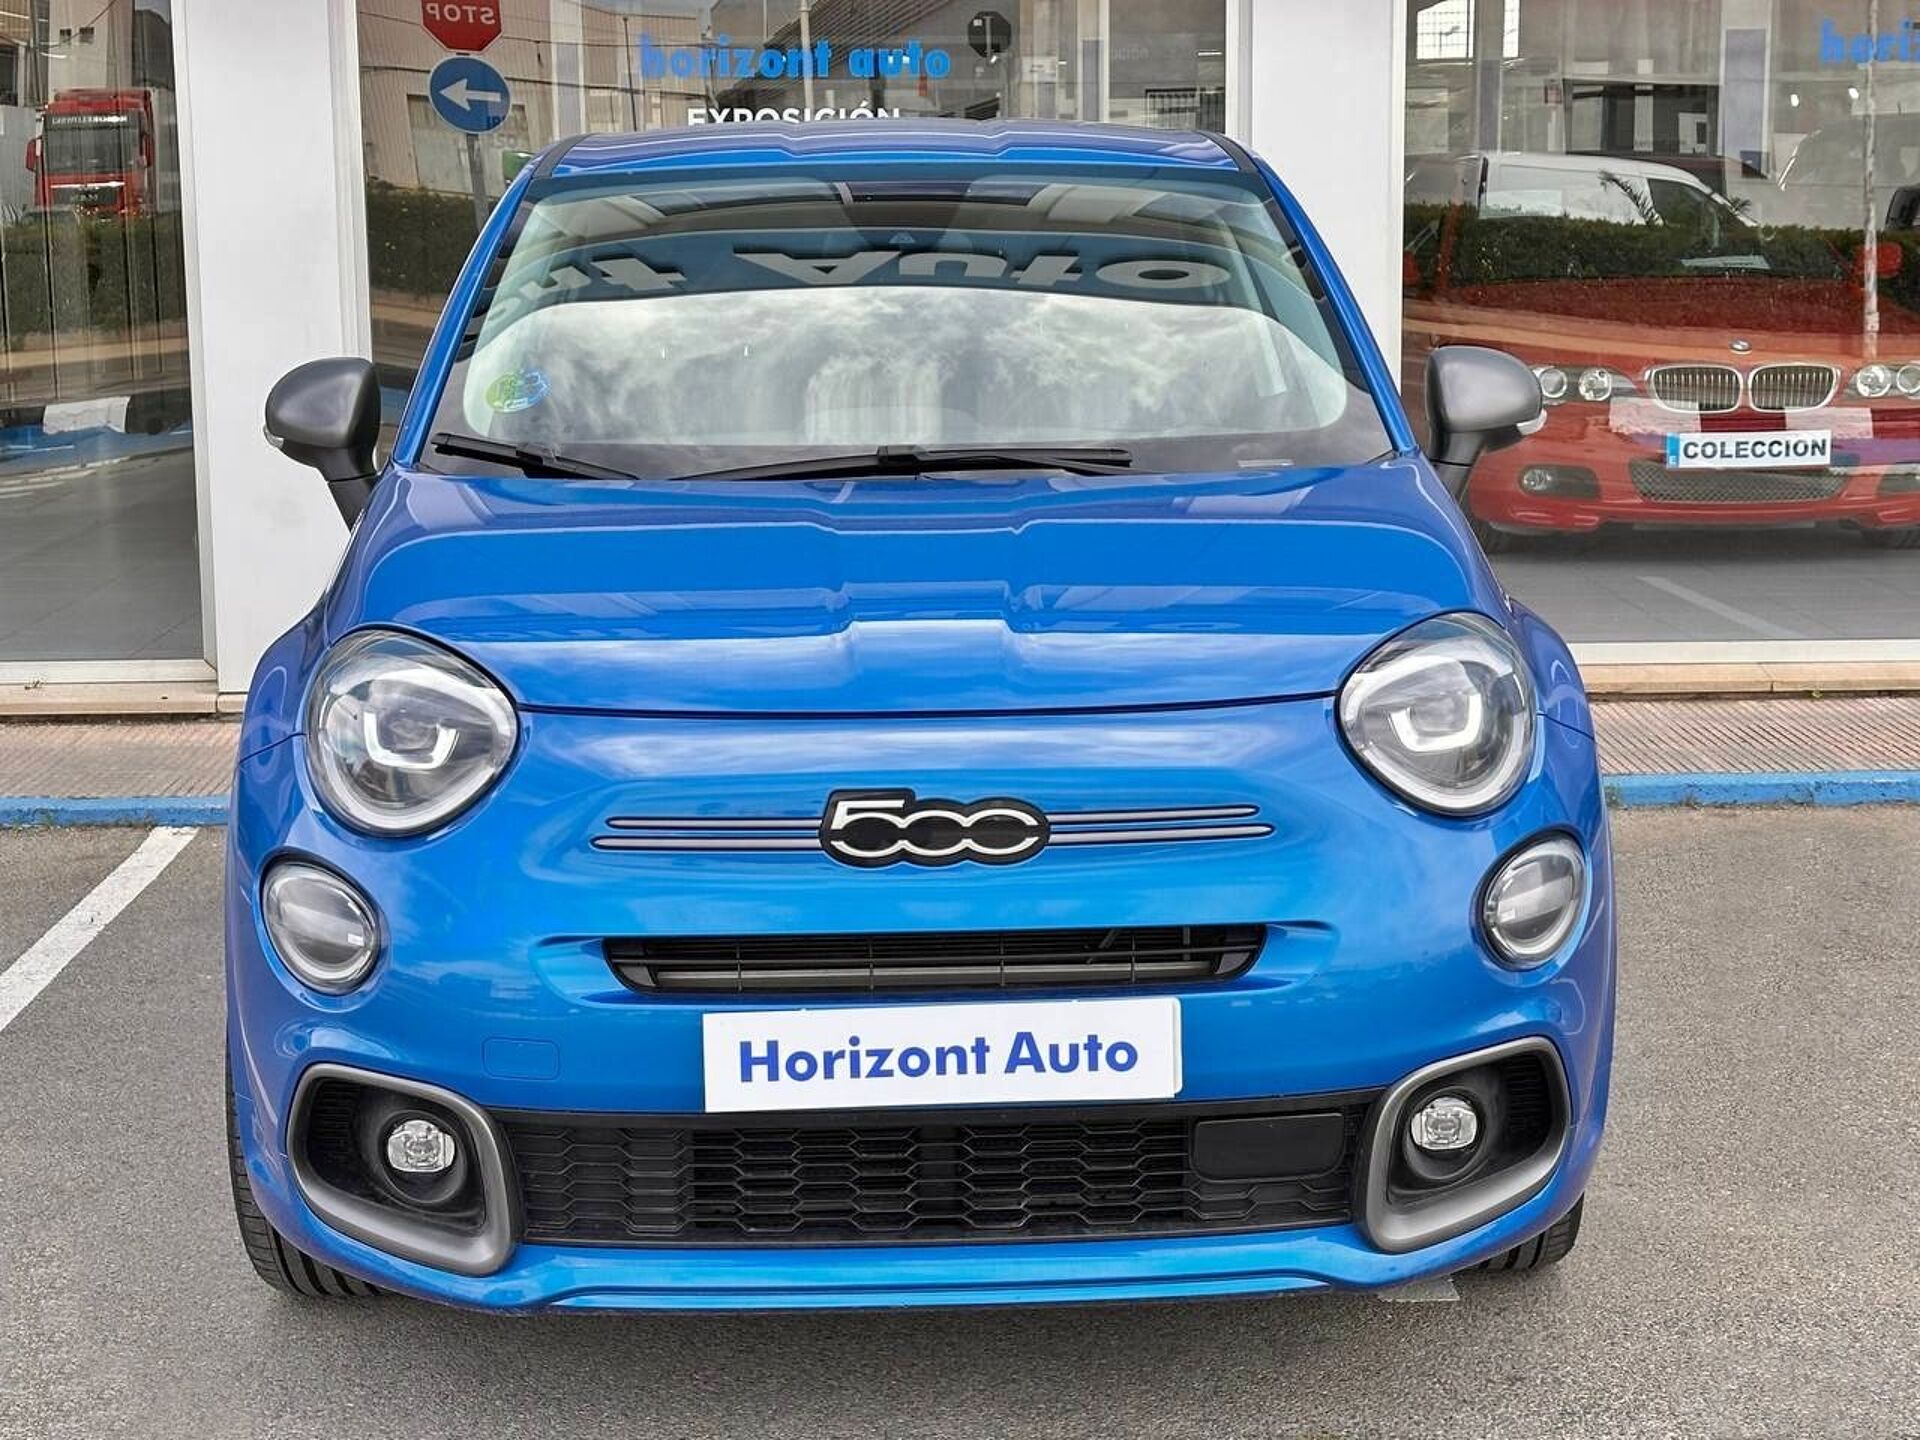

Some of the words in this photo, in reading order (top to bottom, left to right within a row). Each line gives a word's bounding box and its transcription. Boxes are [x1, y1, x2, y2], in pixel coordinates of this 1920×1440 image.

[640, 34, 831, 79] horizont
[849, 39, 950, 79] auto
[1820, 18, 1920, 63] hori
[1683, 439, 1826, 459] COLECCION
[830, 799, 1039, 858] 500
[739, 1035, 990, 1083] Horizont
[1004, 1031, 1138, 1074] Auto
